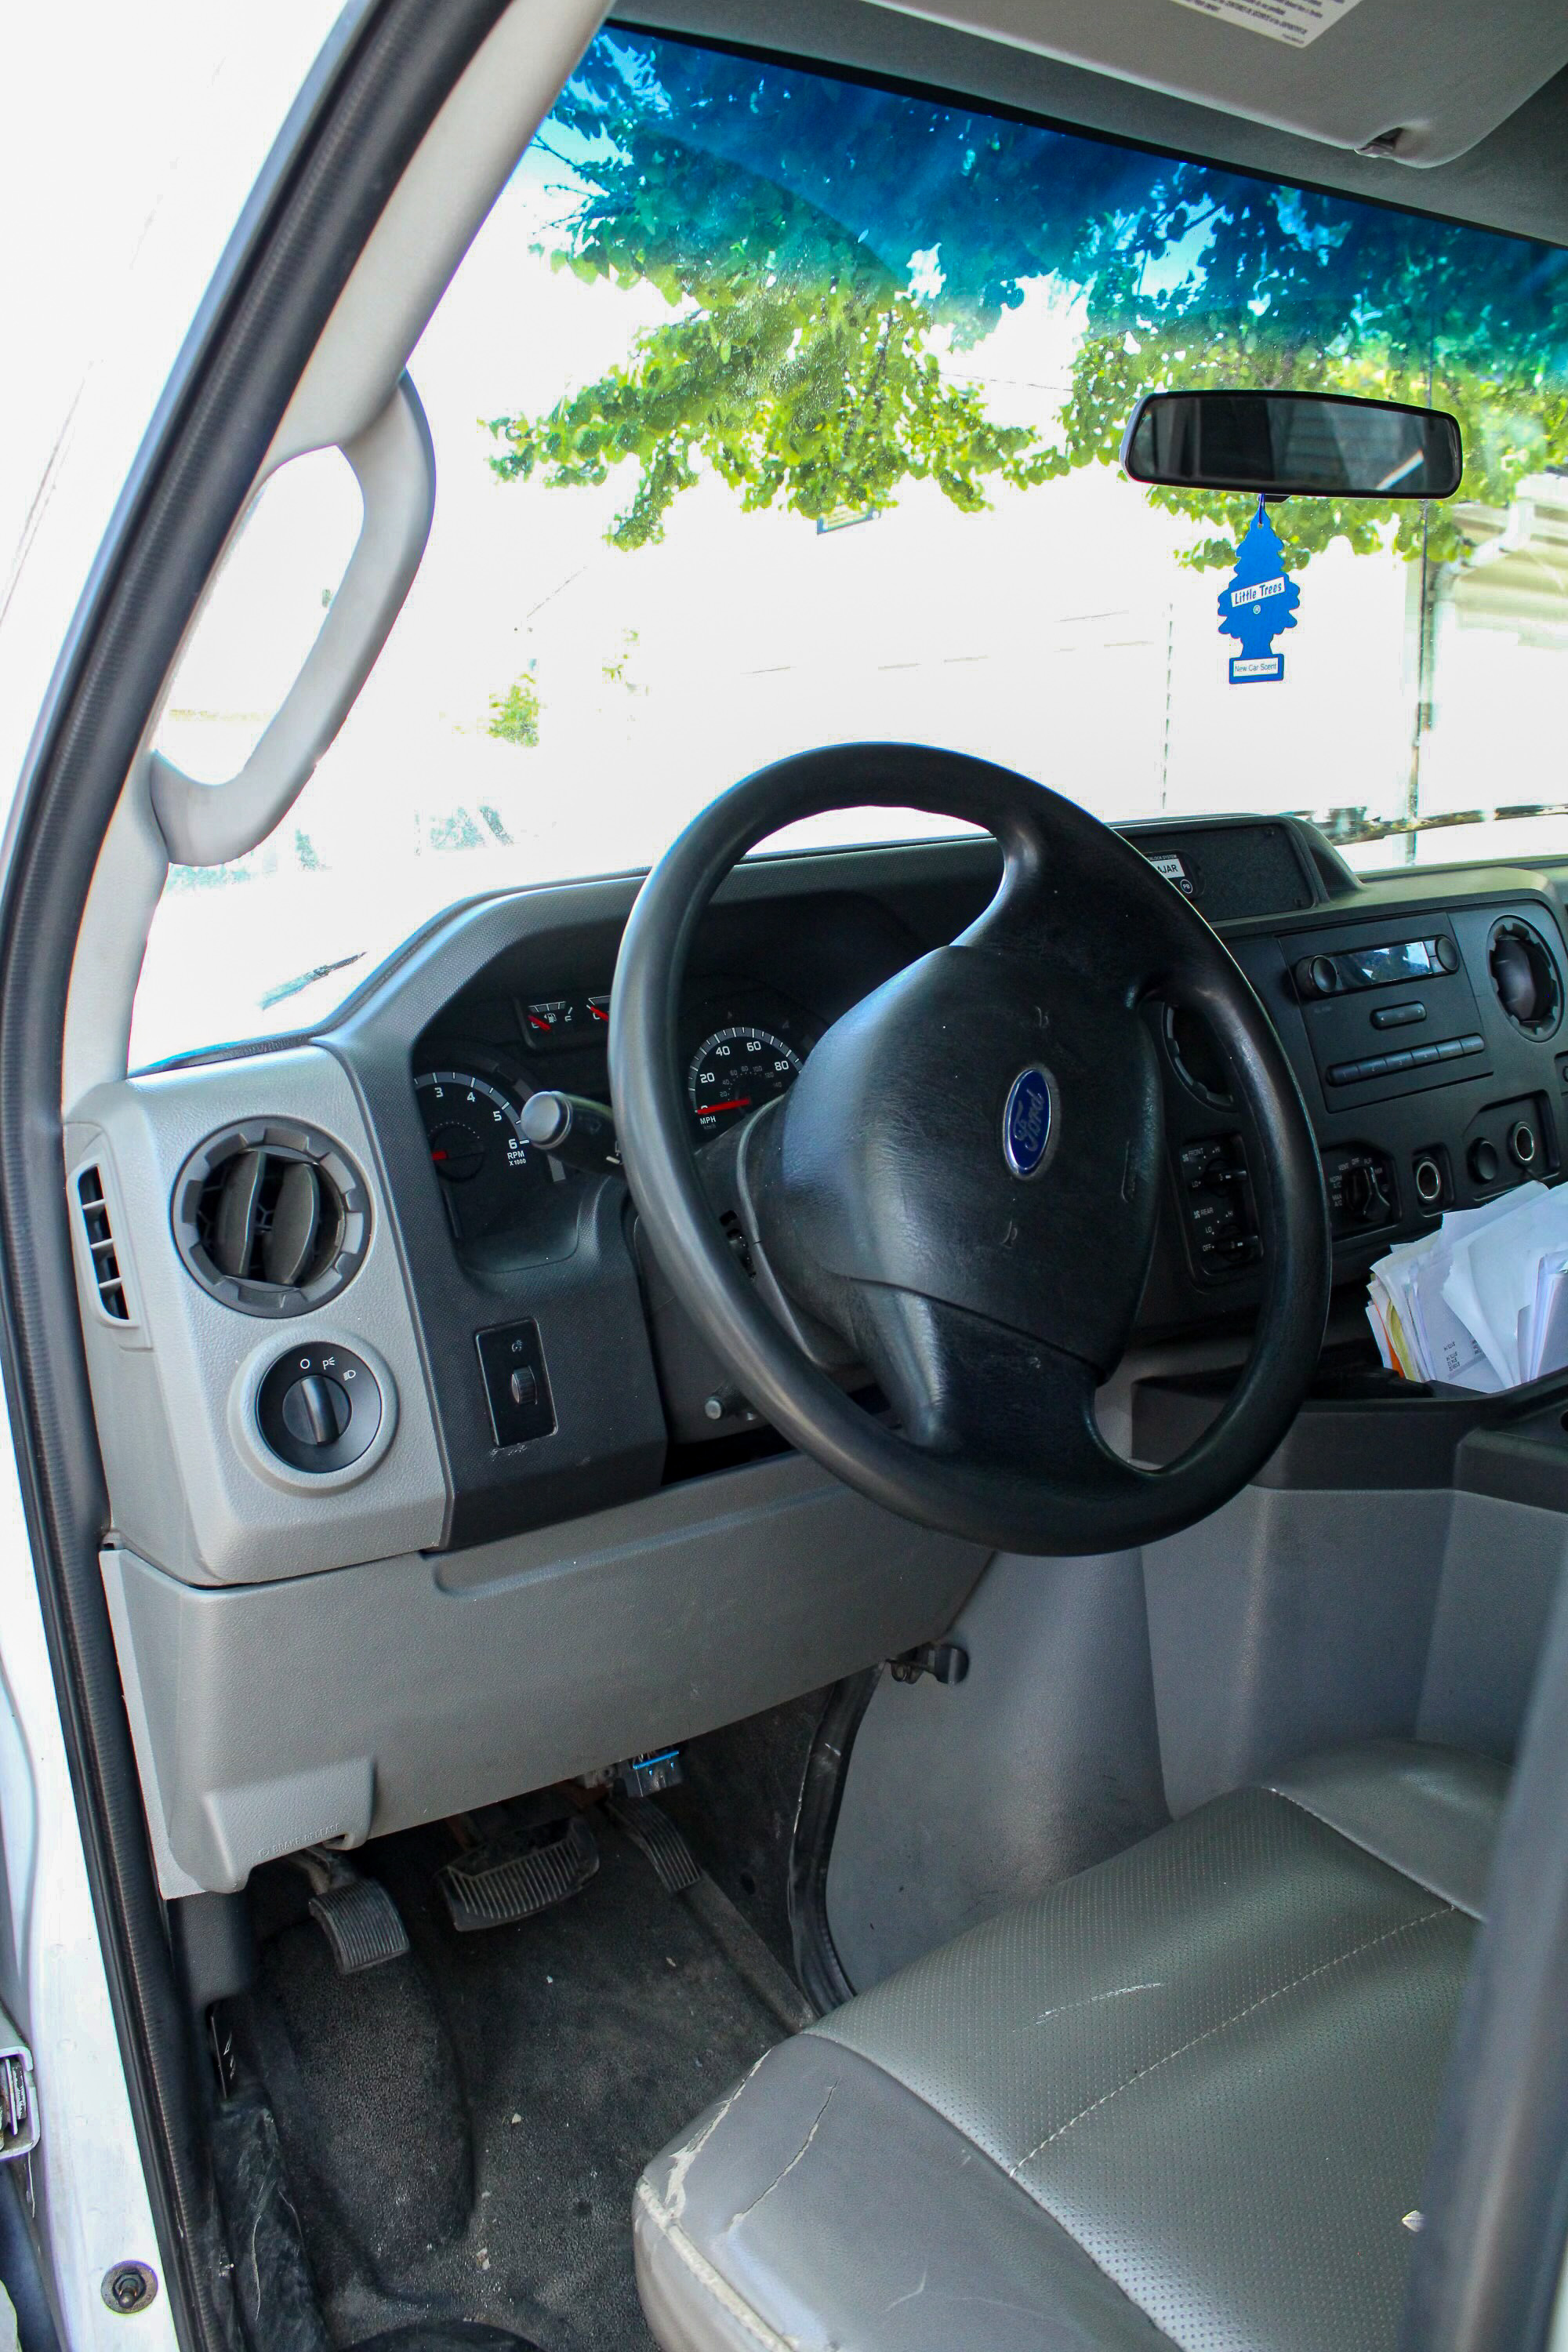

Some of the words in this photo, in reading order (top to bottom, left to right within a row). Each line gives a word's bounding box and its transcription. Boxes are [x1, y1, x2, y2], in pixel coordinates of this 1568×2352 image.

[1234, 588, 1257, 604] Little
[1259, 583, 1282, 597] Trees
[1248, 663, 1259, 672] Car
[1261, 662, 1277, 671] Scent
[716, 1046, 731, 1056] 40
[746, 1041, 762, 1051] 60
[774, 1061, 789, 1071] 80
[699, 1073, 715, 1083] 20
[434, 1087, 444, 1098] 3
[466, 1092, 476, 1102] 4
[493, 1111, 503, 1122] 5
[508, 1139, 517, 1149] 6
[507, 1150, 525, 1160] RPM
[1188, 1148, 1203, 1156] FRONT
[1200, 1207, 1214, 1216] REAR
[1202, 1243, 1211, 1252] OFF
